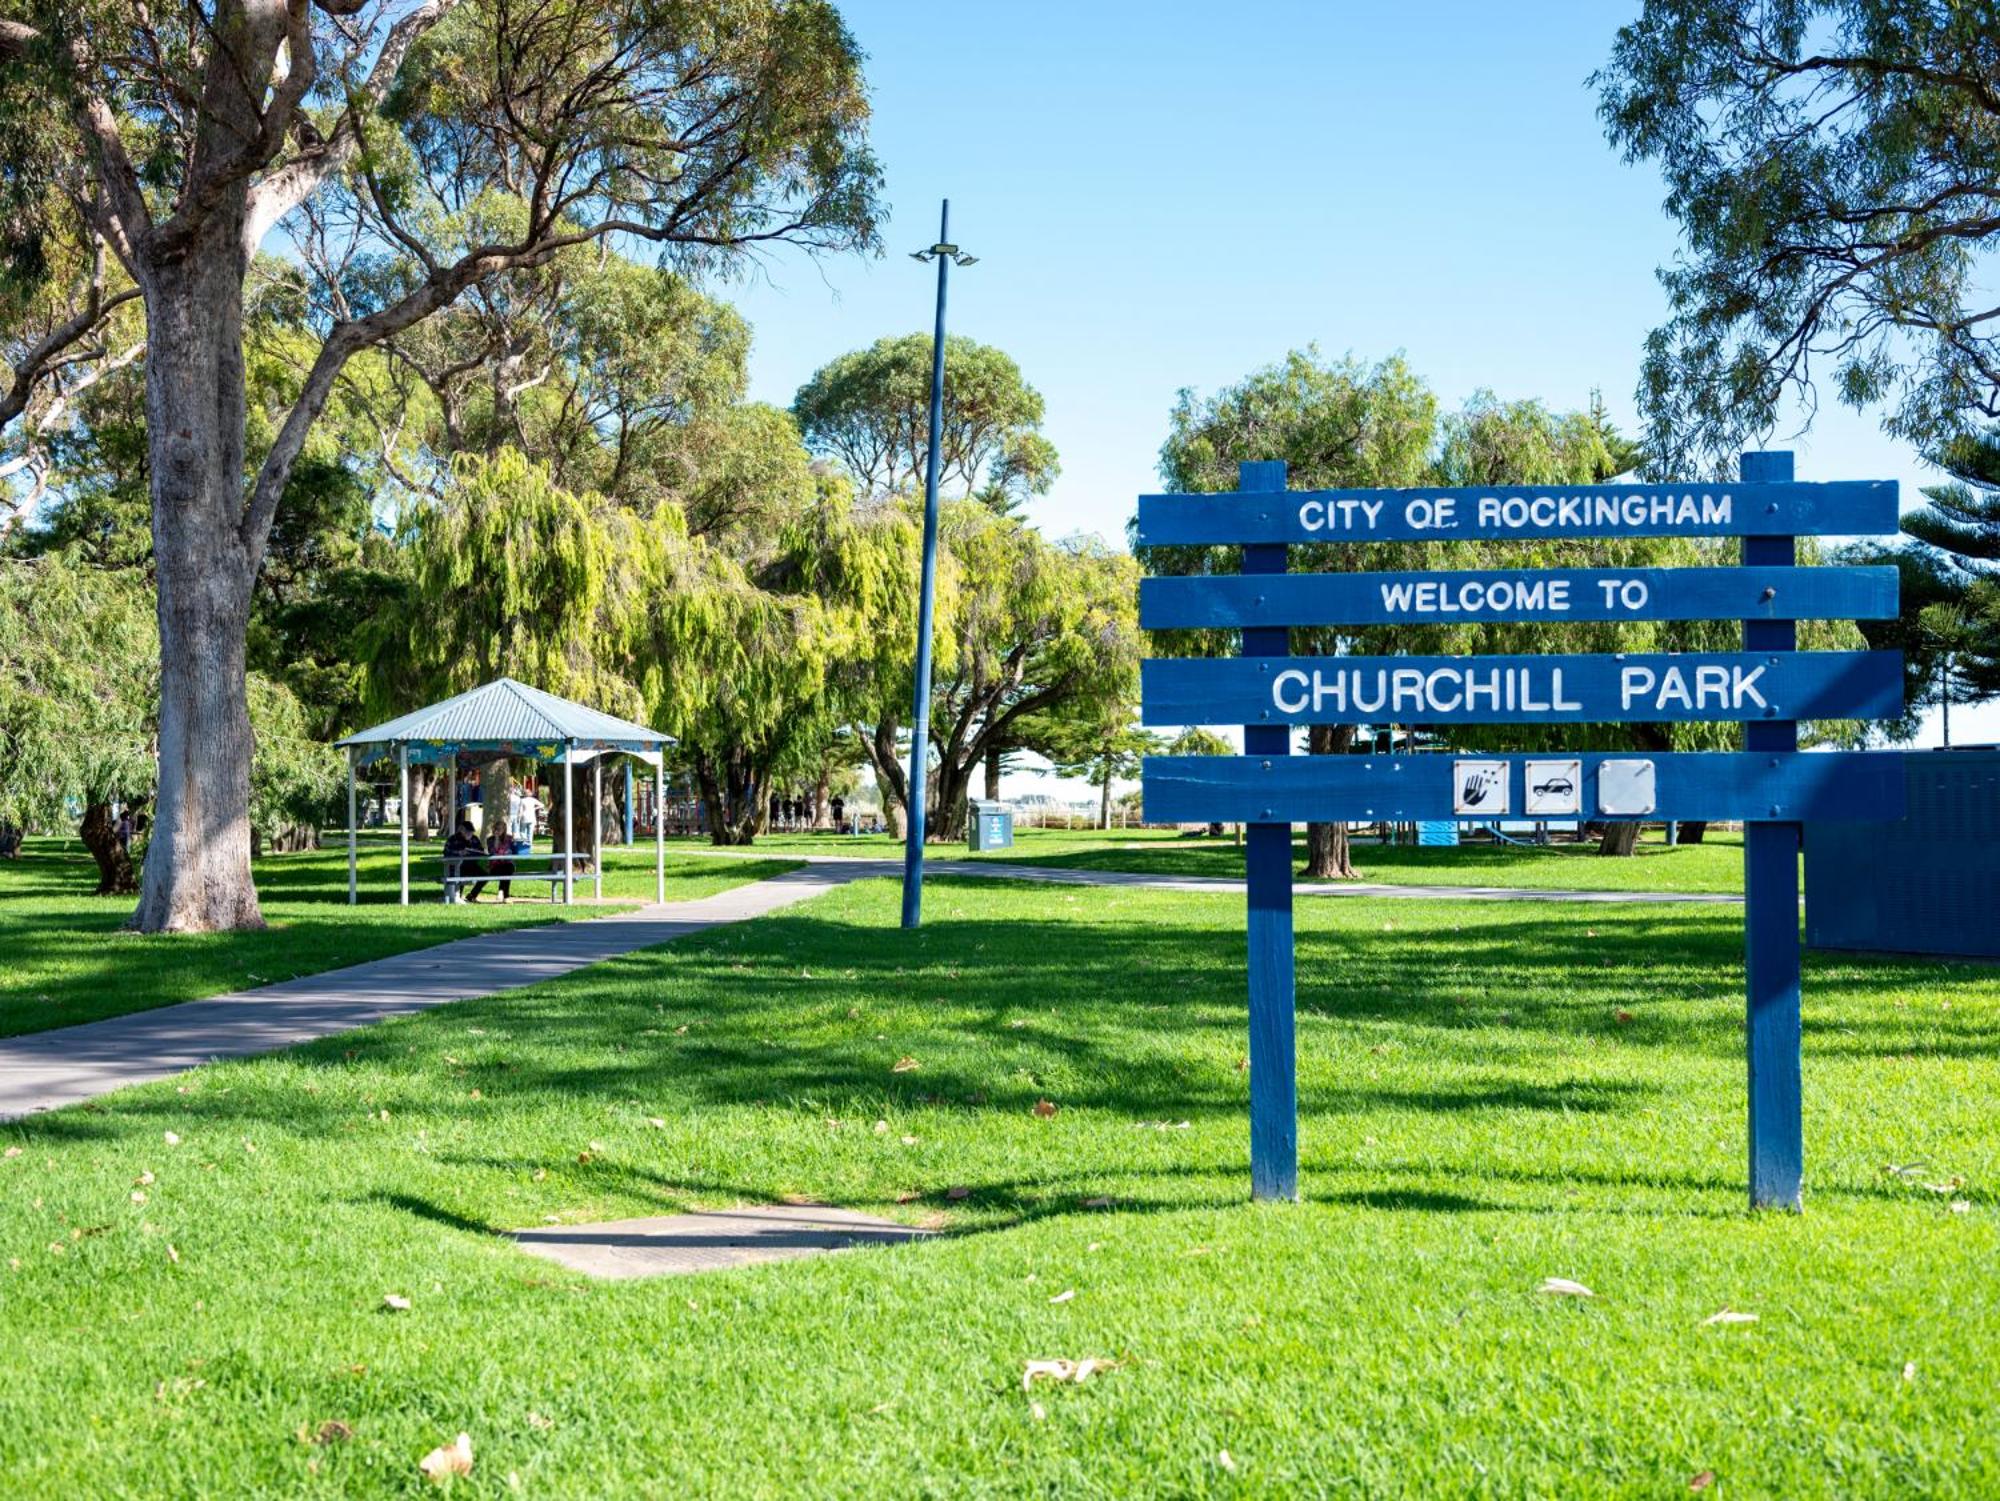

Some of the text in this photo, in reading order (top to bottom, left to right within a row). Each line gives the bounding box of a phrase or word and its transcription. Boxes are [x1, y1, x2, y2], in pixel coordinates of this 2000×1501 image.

[1299, 494, 1733, 532] CITY OF ROCKINGHAM
[1381, 579, 1649, 613] WELCOME TO
[1271, 665, 1768, 715] CHURCHILL PARK
